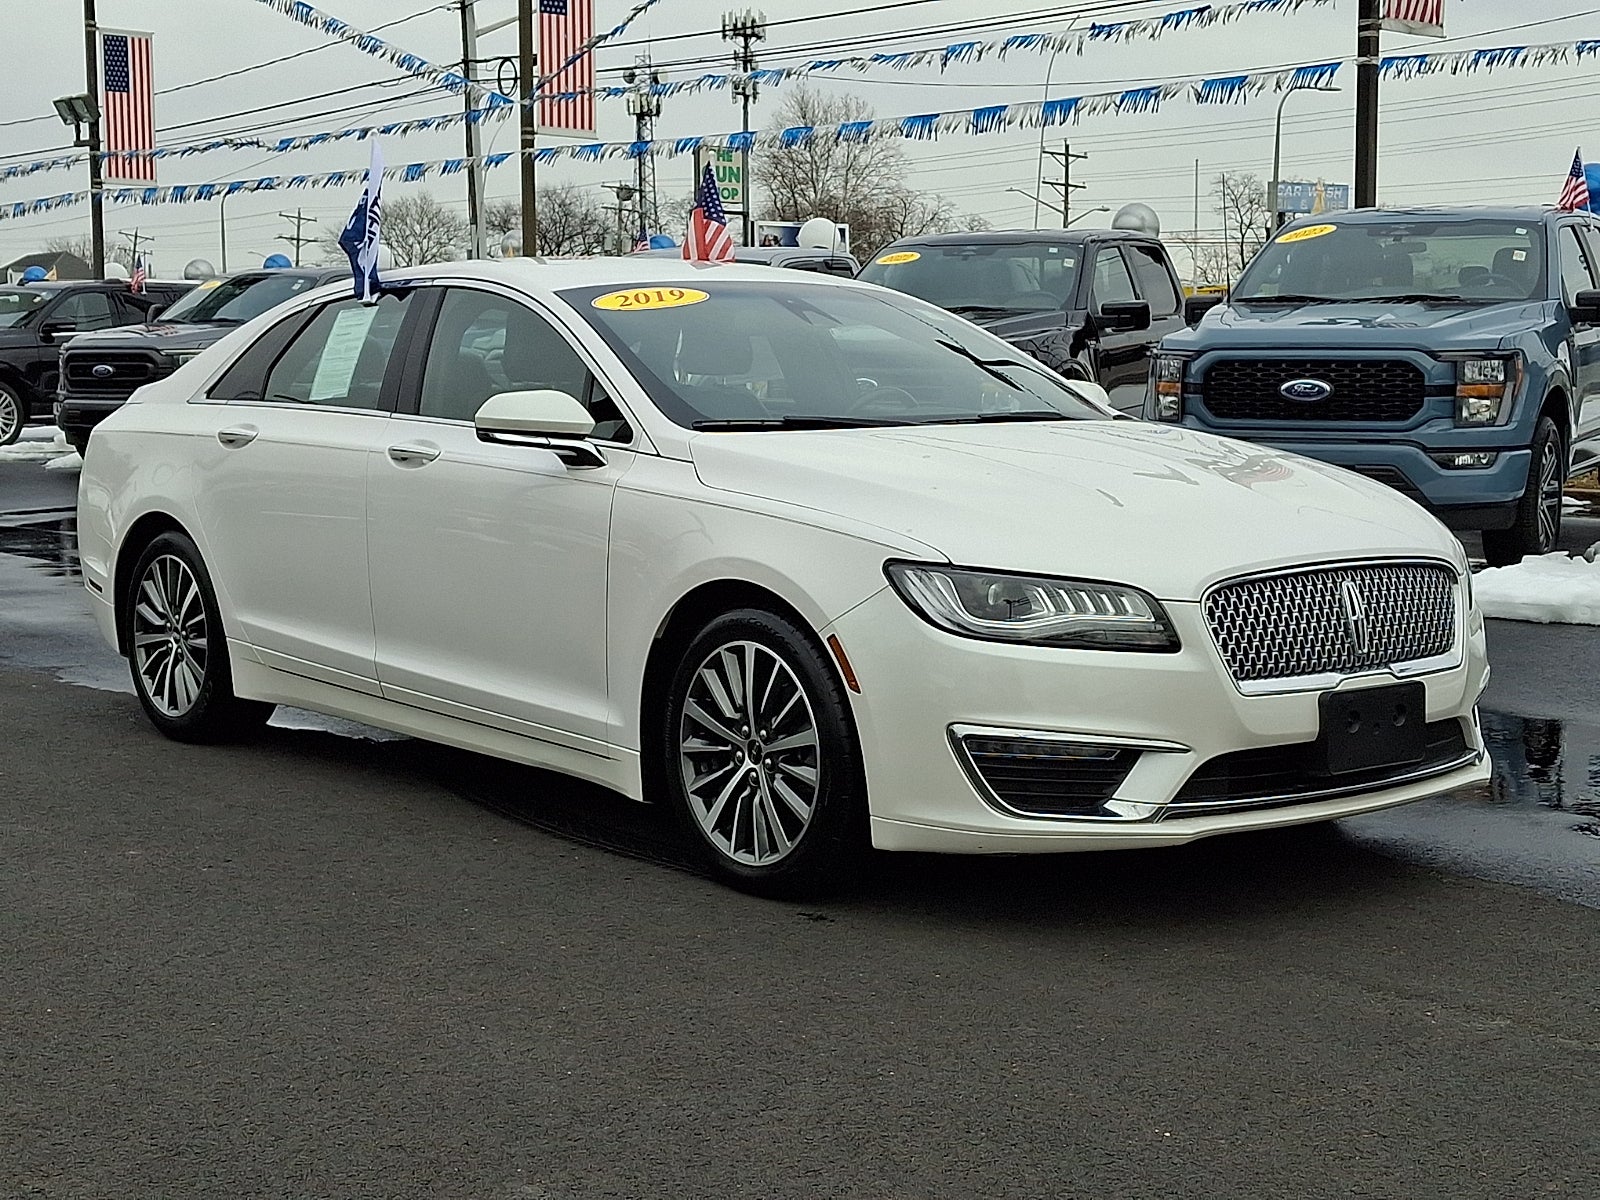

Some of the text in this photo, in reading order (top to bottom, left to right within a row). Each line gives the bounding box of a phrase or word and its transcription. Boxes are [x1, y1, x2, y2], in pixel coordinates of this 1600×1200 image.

[1277, 185, 1343, 199] CAR WSH
[615, 289, 685, 307] 2019
[1292, 383, 1319, 396] Ford
